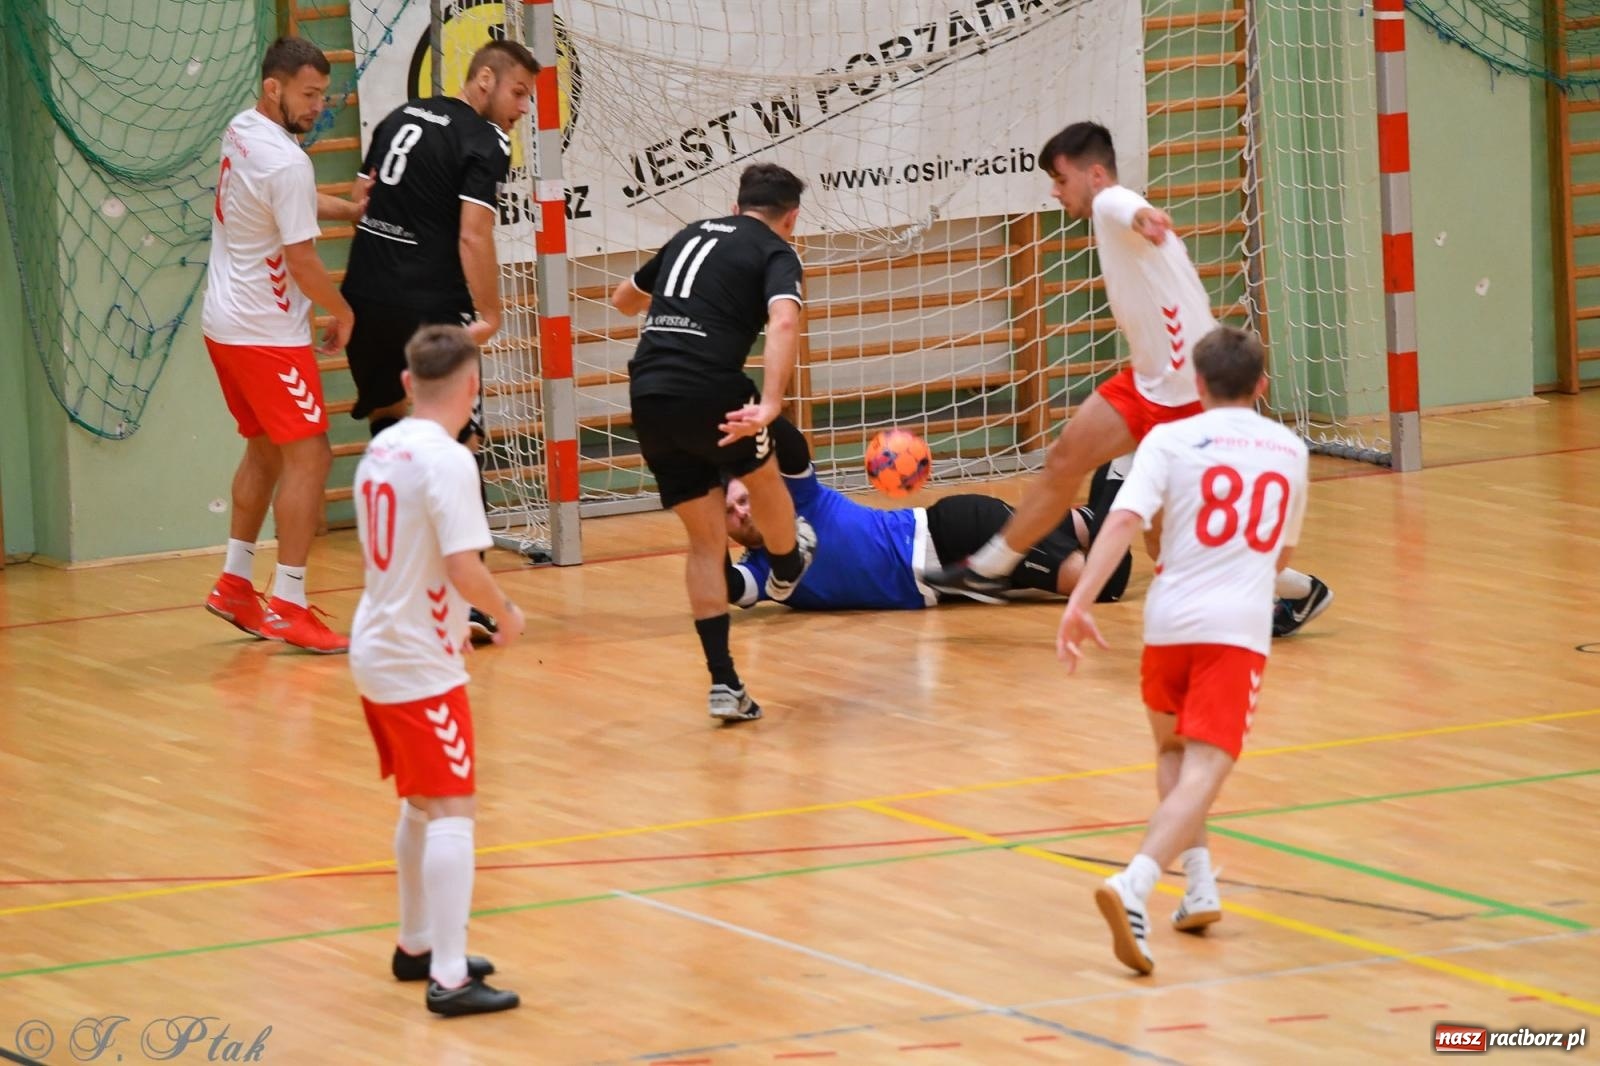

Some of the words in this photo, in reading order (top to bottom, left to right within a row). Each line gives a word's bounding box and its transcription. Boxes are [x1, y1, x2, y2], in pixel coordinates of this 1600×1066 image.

[379, 123, 424, 186] 8
[622, 110, 738, 198] JEST
[751, 87, 801, 139] W
[819, 147, 1037, 192] www.osir-racib
[664, 235, 719, 298] 11
[361, 479, 397, 572] 10
[1195, 464, 1290, 553] 80
